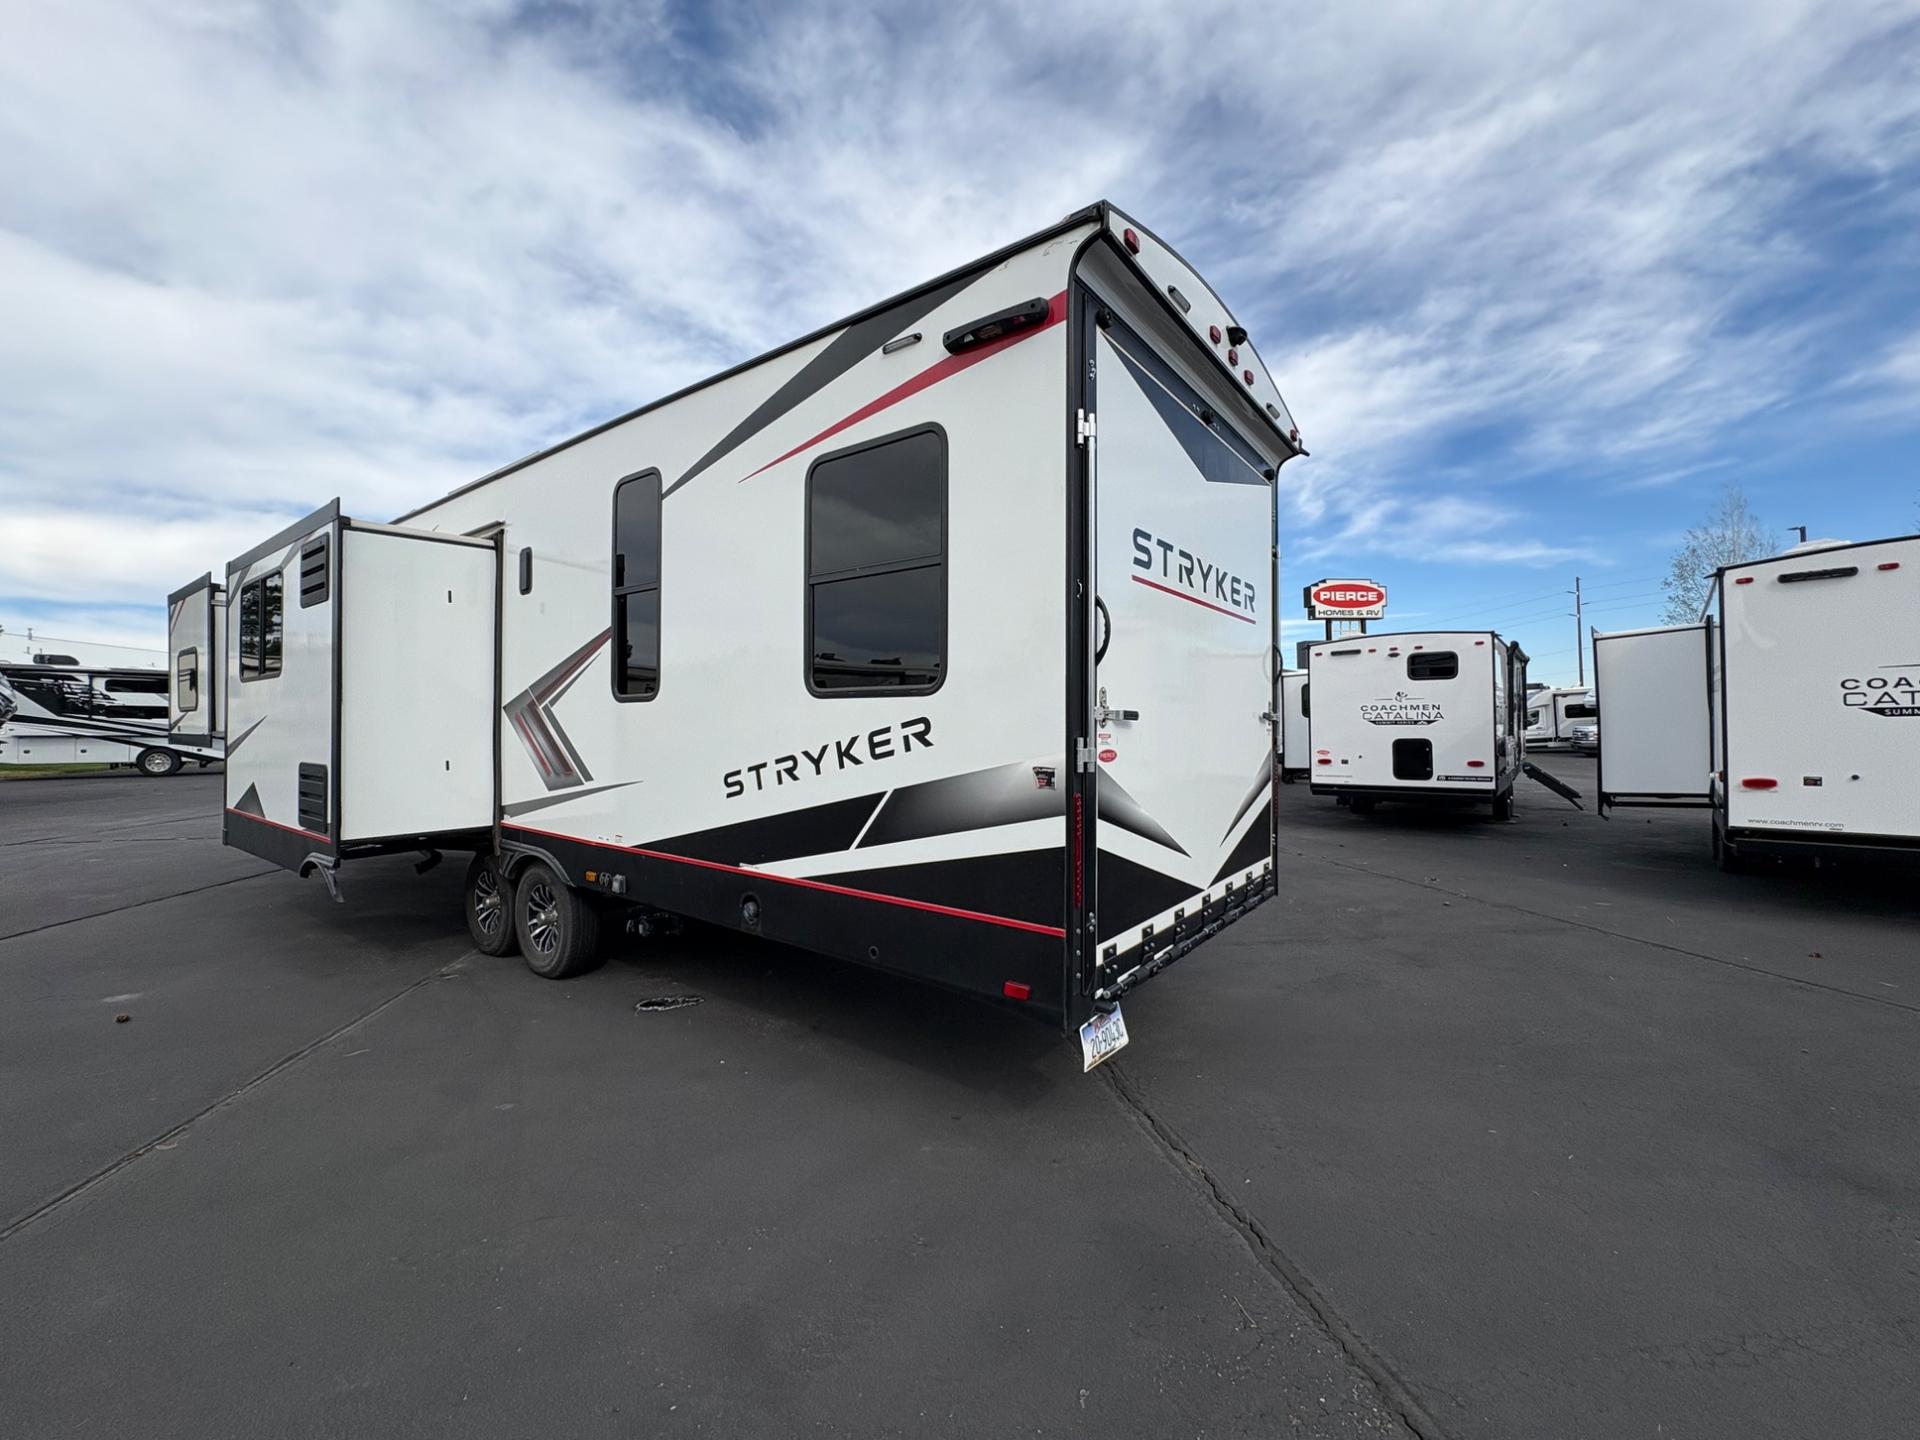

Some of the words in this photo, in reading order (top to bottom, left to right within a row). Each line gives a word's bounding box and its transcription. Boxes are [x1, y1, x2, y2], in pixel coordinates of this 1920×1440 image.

[1132, 527, 1256, 613] STRYKER
[1320, 591, 1378, 601] PIERCE
[1840, 677, 1920, 690] COA
[1362, 711, 1445, 720] CATALINA
[723, 716, 935, 799] STRYKER
[1747, 819, 1845, 828] www.coachmenrv.com
